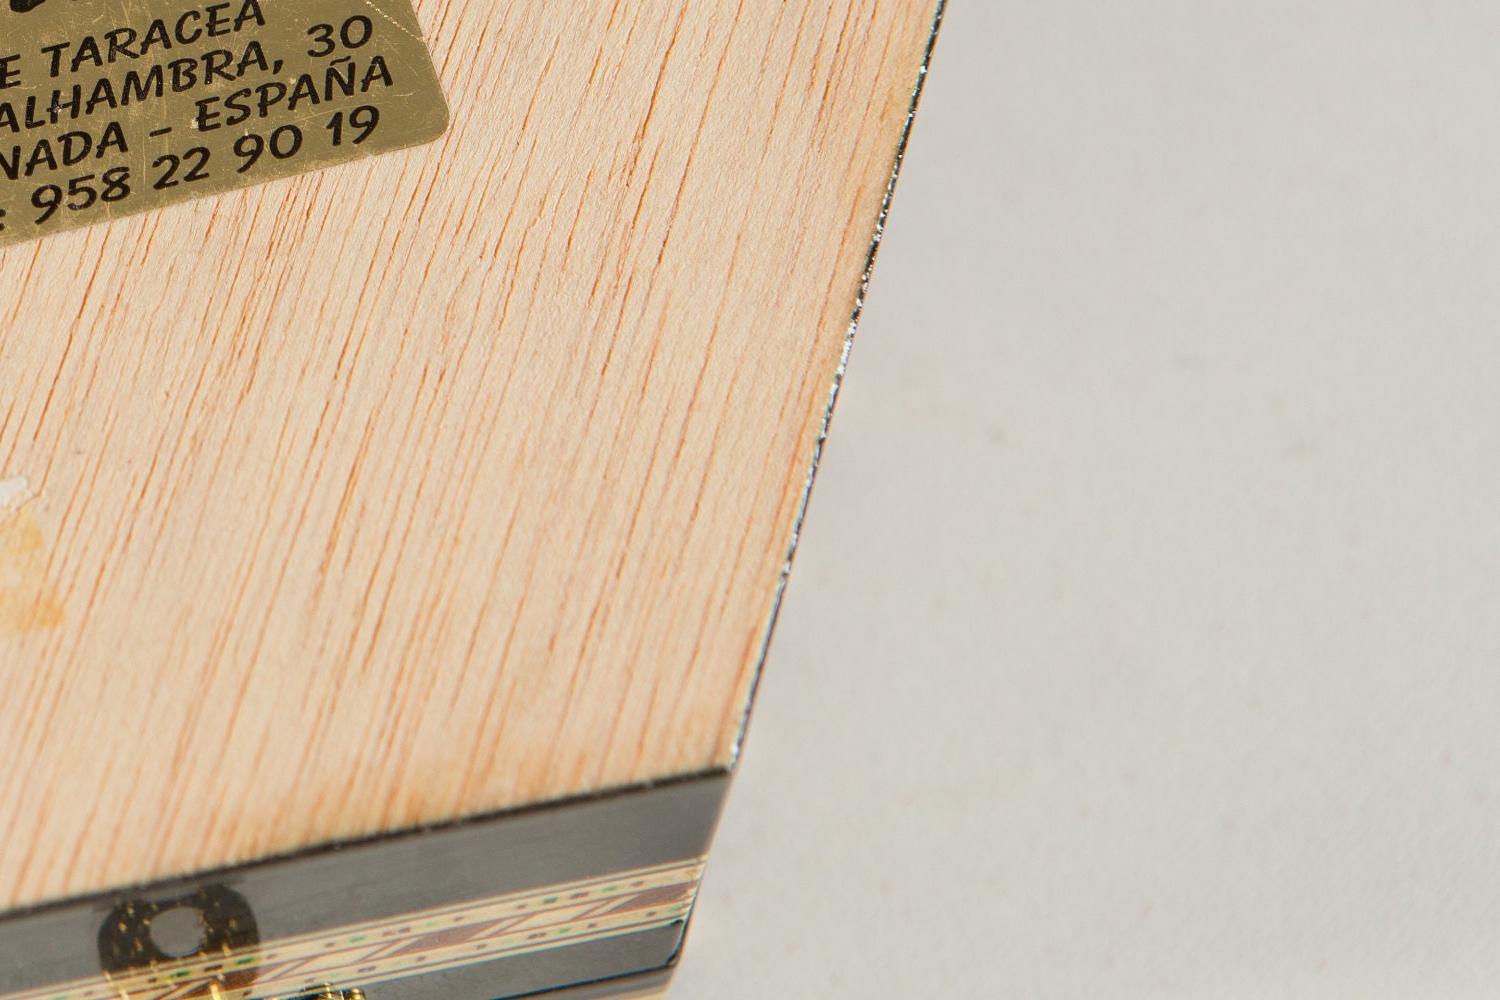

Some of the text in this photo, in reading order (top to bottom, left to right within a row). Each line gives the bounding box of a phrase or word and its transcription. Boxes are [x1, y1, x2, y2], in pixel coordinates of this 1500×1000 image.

[307, 14, 373, 58] 30
[194, 55, 394, 133] ESPAÑA
[30, 166, 131, 225] 958
[151, 146, 211, 191] 22
[233, 124, 303, 174] 90
[326, 105, 380, 147] 19
